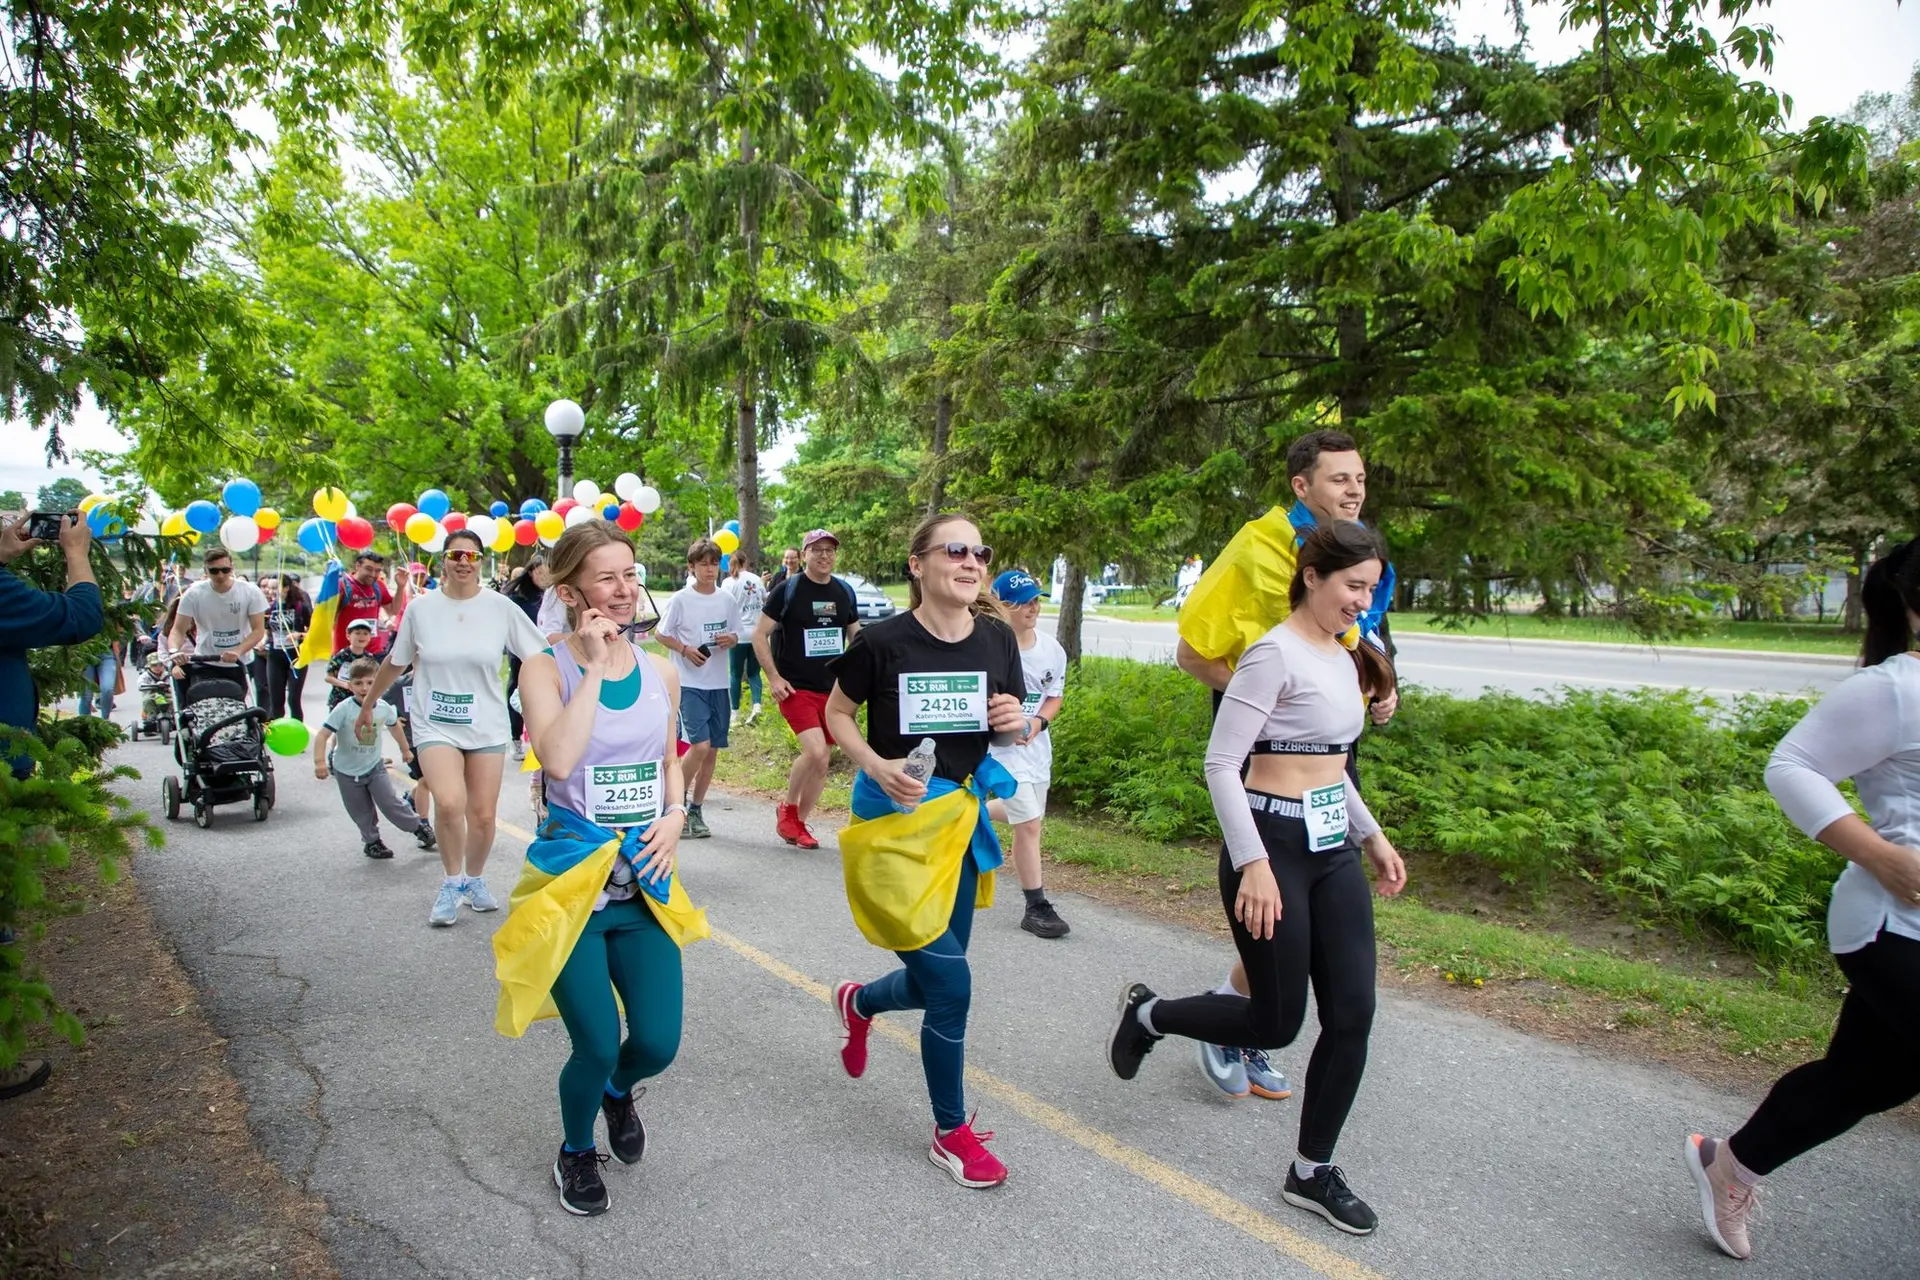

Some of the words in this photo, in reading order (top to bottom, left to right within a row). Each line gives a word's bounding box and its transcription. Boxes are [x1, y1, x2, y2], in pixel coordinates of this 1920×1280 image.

[813, 639, 836, 647] 24252
[908, 680, 926, 692] 33
[929, 684, 948, 692] RUN
[436, 704, 469, 714] 24208
[921, 698, 968, 712] 24216
[595, 770, 614, 783] 33
[617, 772, 637, 782] RUN
[605, 785, 653, 803] 24255
[1312, 793, 1328, 806] 33
[595, 802, 635, 811] Oleksandra
[1268, 798, 1304, 818] PUM
